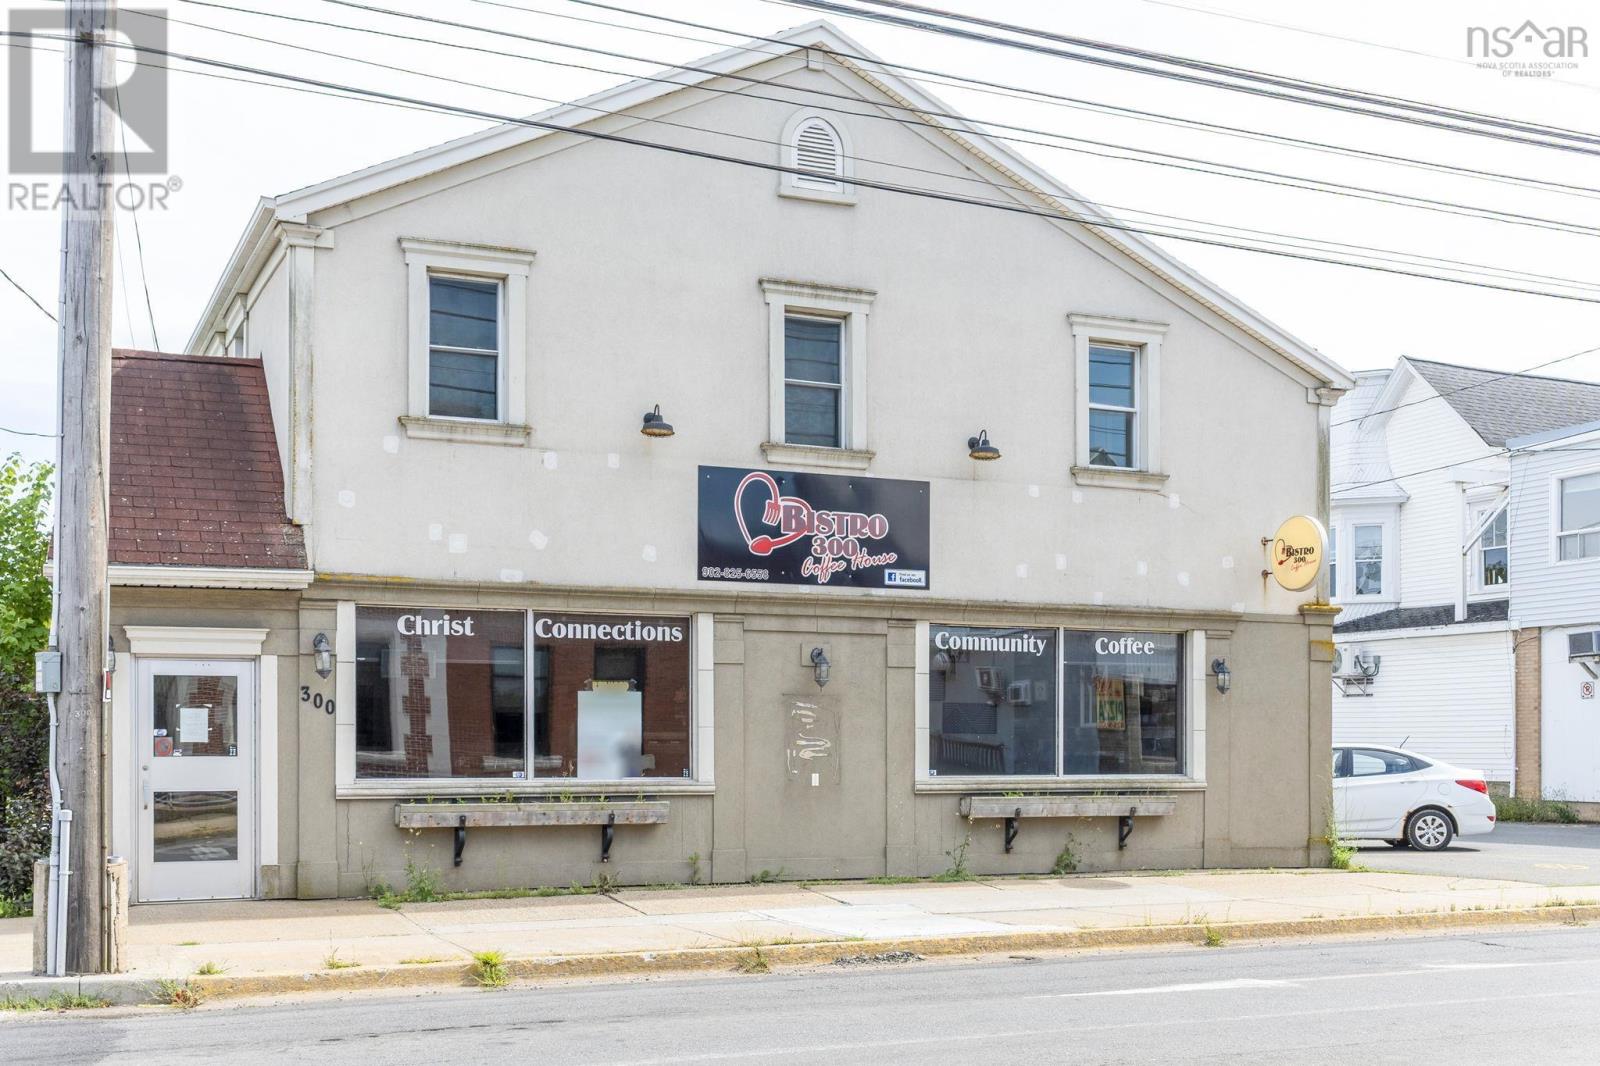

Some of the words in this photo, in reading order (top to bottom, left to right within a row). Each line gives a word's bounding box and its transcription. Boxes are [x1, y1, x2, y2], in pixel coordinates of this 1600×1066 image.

[811, 536, 859, 559] 300
[801, 555, 847, 584] Coffee
[851, 547, 897, 570] House
[396, 615, 475, 636] Christ
[535, 618, 683, 642] Connections
[935, 631, 1047, 656] Community
[1094, 637, 1155, 655] Coffee
[301, 686, 335, 715] 300
